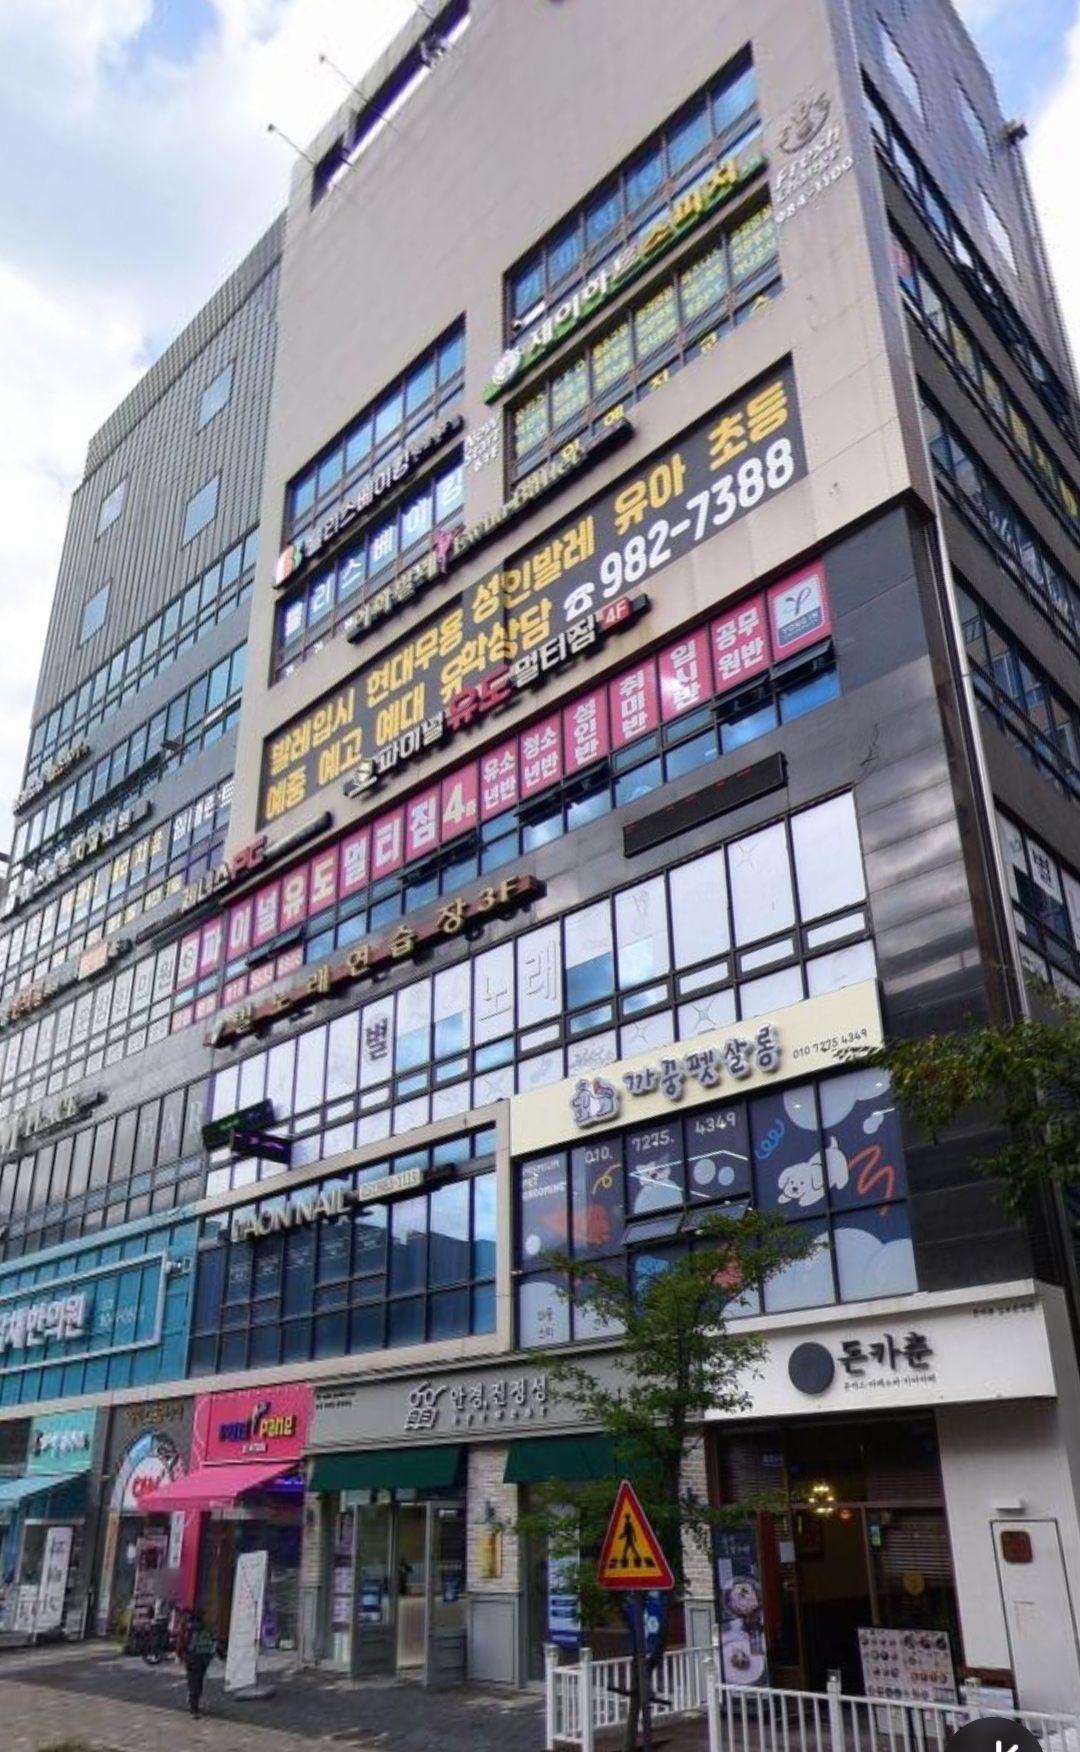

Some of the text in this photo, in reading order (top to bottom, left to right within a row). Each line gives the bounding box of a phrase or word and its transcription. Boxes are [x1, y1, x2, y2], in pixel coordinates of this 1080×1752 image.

[269, 379, 788, 776] 발레입시 현대무용 성인발레 유아 초등
[317, 729, 363, 784] 예고
[375, 688, 425, 748] 예대
[440, 597, 552, 708] 유학상담
[601, 439, 795, 599] 982-7388
[603, 600, 628, 628] 4F
[573, 697, 599, 766] 성인반
[484, 749, 516, 782] 유소
[480, 875, 523, 909] 3F
[624, 1025, 779, 1098] 까꿍펫살롱
[841, 1028, 868, 1046] 4349
[695, 1112, 737, 1135] 4349
[295, 1185, 352, 1224] NAIL
